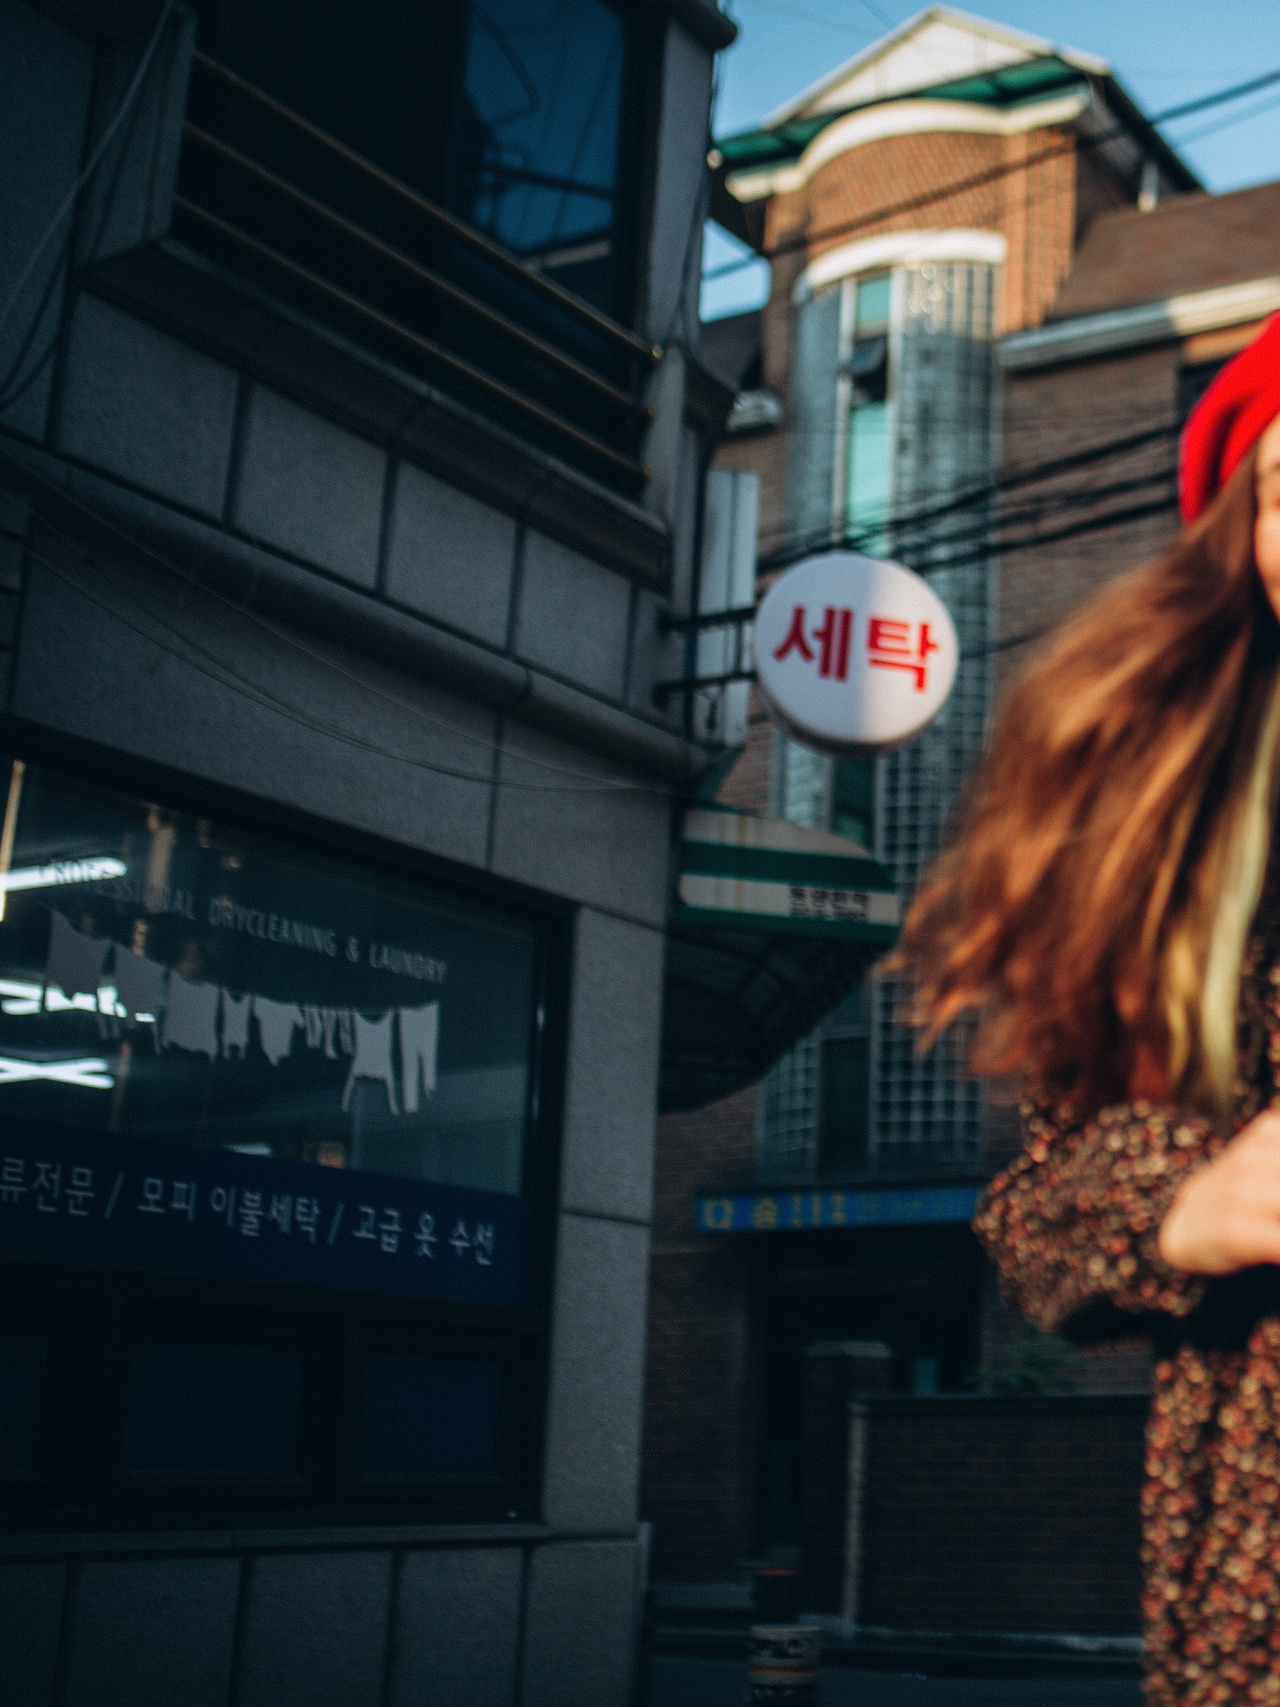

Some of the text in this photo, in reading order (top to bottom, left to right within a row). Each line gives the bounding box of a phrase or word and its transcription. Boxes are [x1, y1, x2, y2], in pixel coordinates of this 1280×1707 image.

[773, 606, 939, 693] 세탁
[208, 895, 338, 957] DRYCLEANING
[345, 934, 360, 963] &
[368, 941, 448, 985] LAUNDRY
[136, 1176, 198, 1223] 모피
[209, 1185, 321, 1244] 이불세탁
[351, 1204, 403, 1254] 고급
[413, 1210, 438, 1259] 옷
[447, 1219, 495, 1267] 수선
